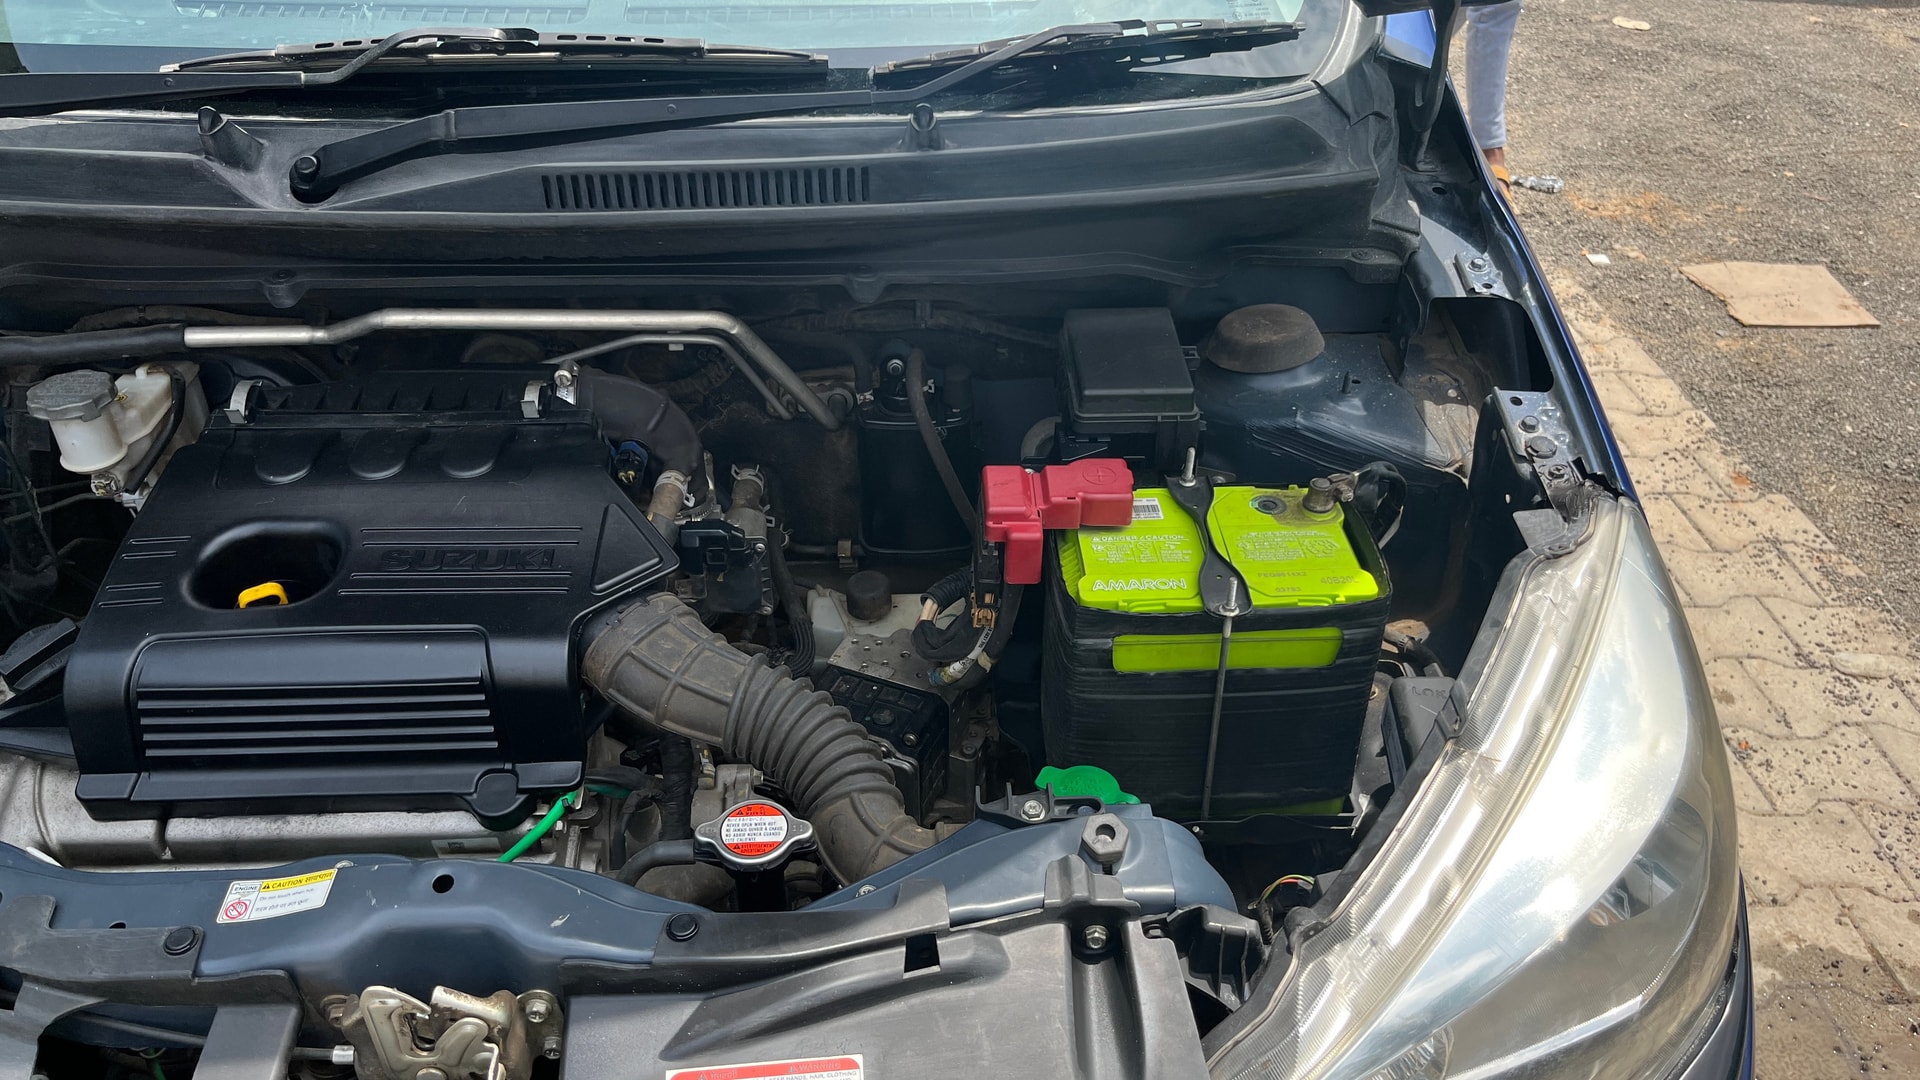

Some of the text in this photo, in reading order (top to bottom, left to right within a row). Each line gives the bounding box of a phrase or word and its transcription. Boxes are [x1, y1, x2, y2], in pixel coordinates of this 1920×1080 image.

[381, 549, 555, 571] SUZUKI
[1092, 578, 1187, 592] AMARON
[271, 879, 303, 890] CAUTION
[799, 1062, 841, 1071] WARNING
